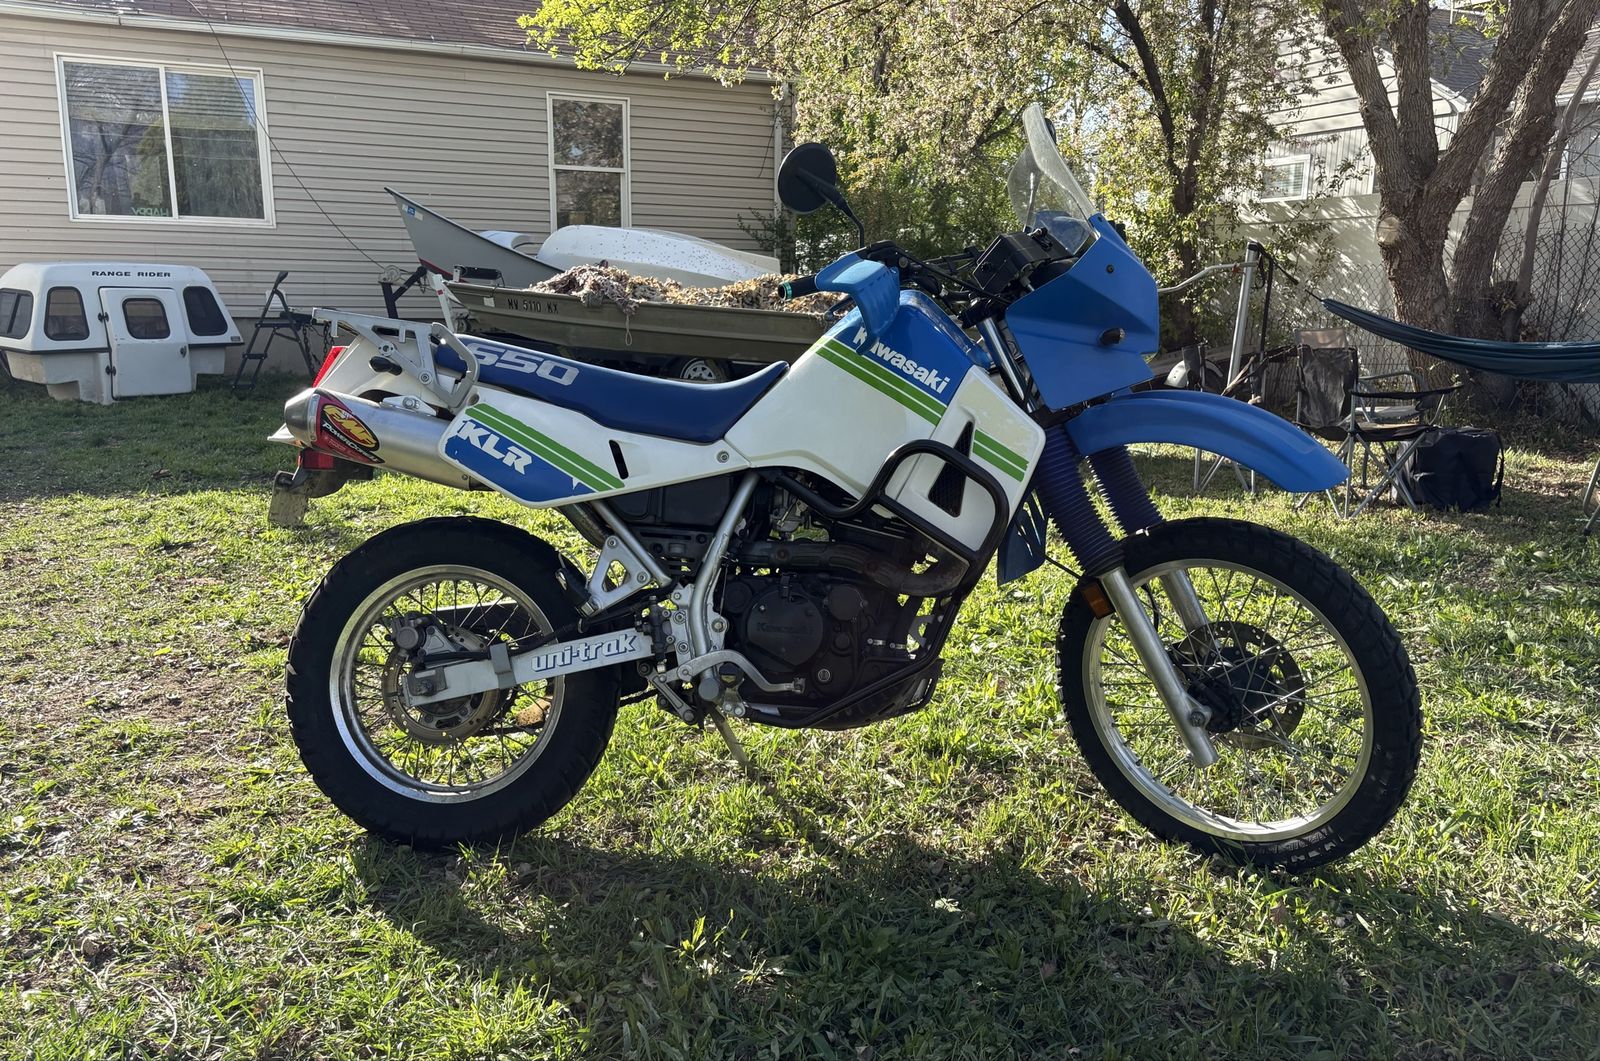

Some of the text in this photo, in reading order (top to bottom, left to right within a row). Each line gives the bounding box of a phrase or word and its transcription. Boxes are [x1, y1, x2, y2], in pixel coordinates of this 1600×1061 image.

[322, 404, 378, 447] FMF
[457, 420, 533, 475] KLR
[531, 634, 637, 672] uni-trak
